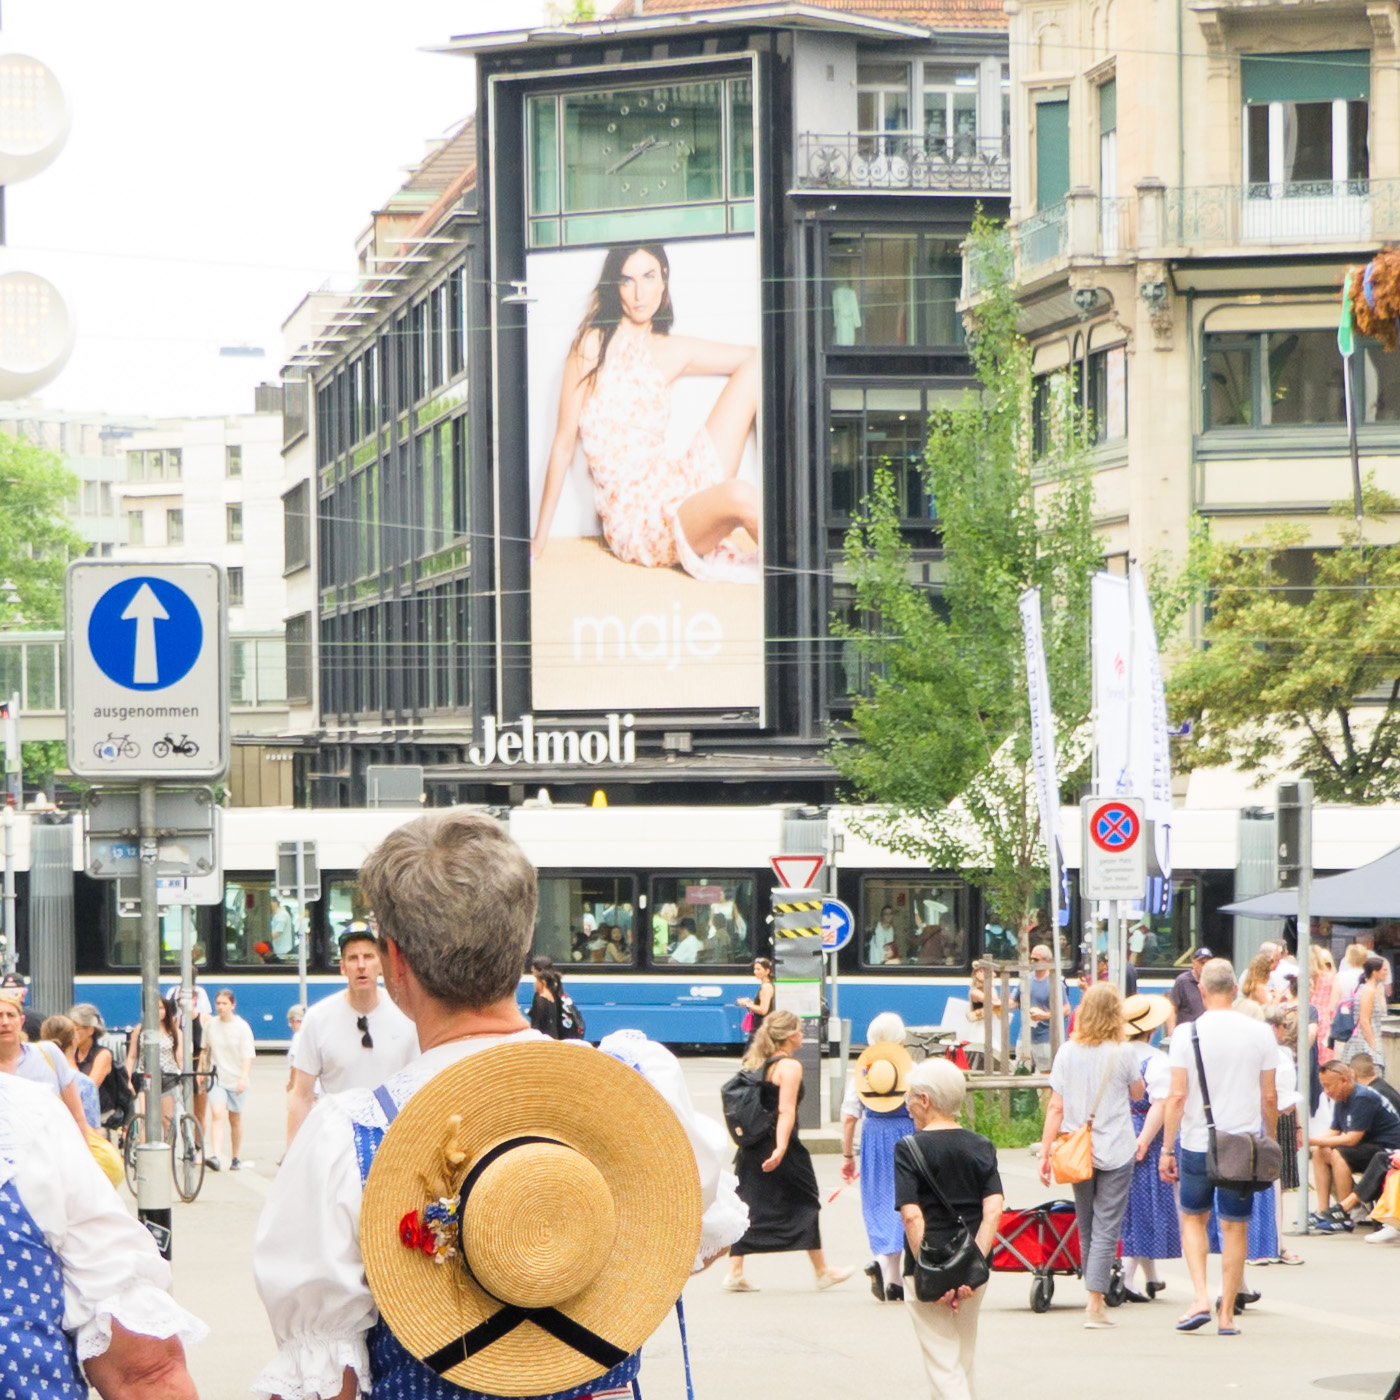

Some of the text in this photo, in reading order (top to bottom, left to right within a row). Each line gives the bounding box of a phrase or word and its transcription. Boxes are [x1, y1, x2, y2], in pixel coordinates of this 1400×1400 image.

[572, 601, 724, 671] maje
[93, 706, 199, 721] ausgenommen
[468, 713, 636, 767] Jelmoli
